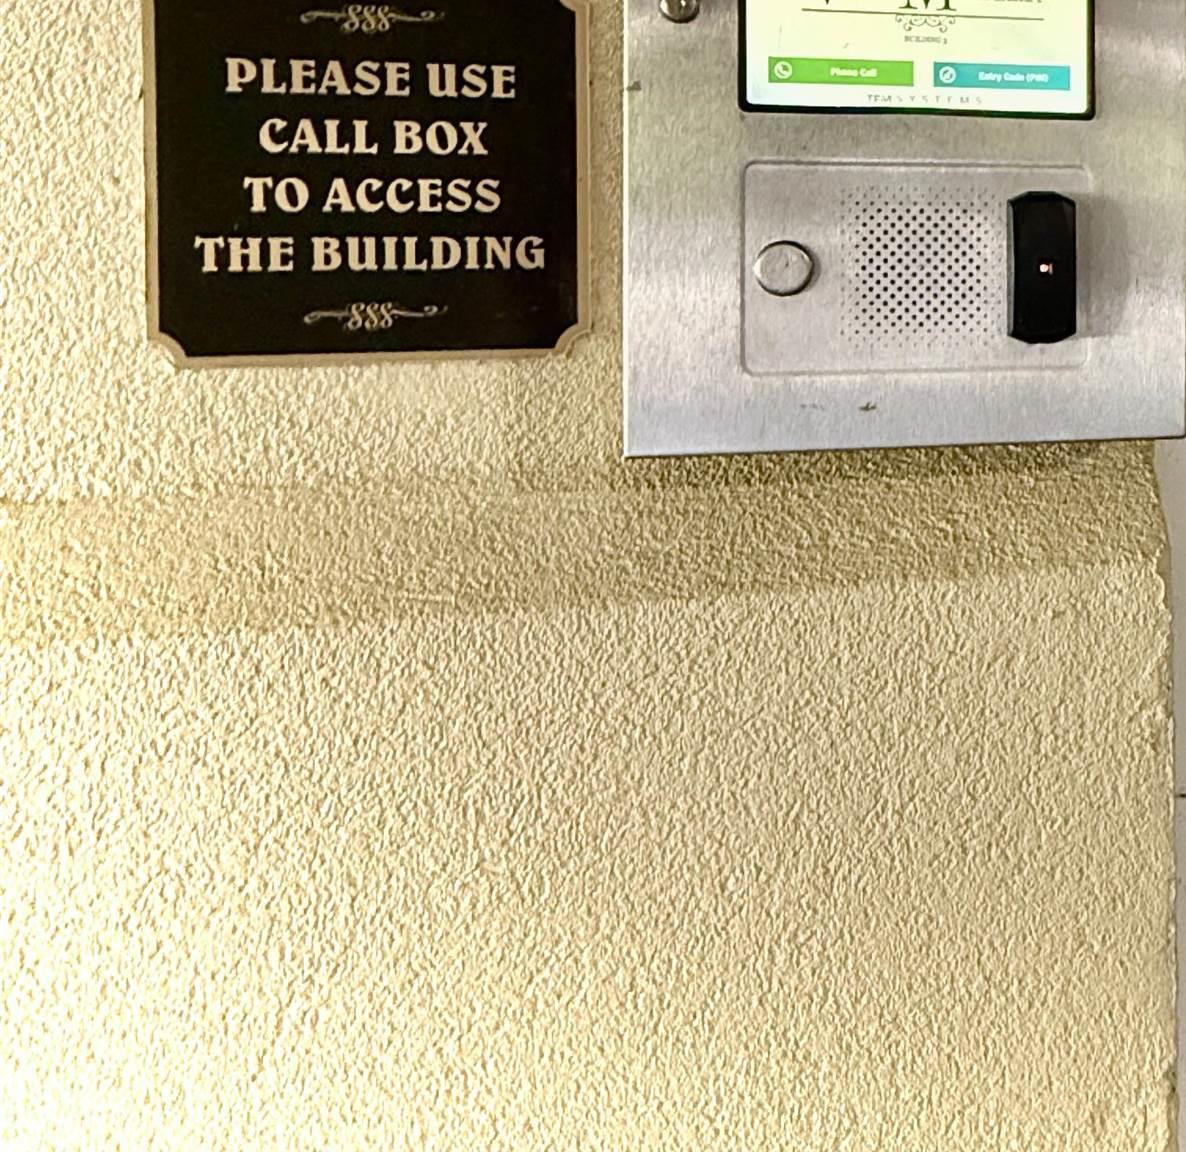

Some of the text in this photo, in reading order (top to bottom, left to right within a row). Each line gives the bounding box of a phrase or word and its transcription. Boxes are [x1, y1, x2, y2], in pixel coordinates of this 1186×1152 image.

[224, 57, 517, 99] PLEASE USE
[859, 67, 878, 78] Call
[978, 71, 1002, 83] Entry
[1003, 71, 1025, 82] Code
[259, 117, 489, 156] CALL BOX
[243, 177, 502, 213] TO ACCESS
[194, 235, 546, 273] THE BUILDING
